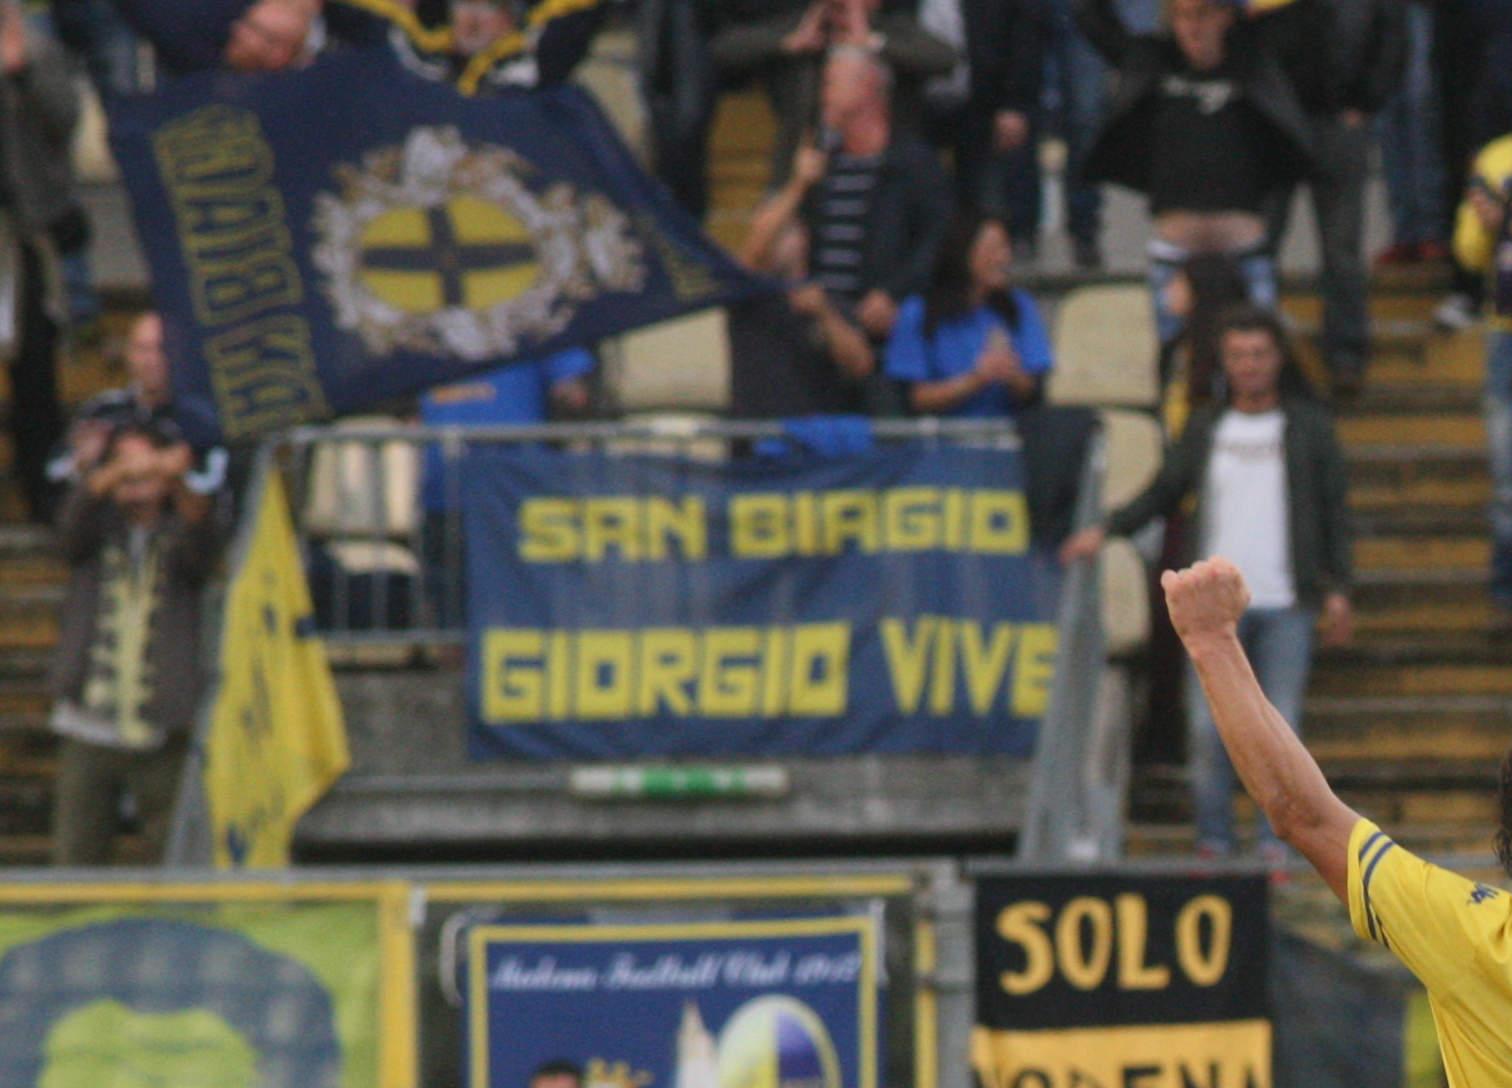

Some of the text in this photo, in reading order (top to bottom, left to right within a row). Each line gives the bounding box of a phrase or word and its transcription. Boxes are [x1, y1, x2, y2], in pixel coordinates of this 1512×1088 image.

[518, 489, 1031, 565] SAN BIAGIO
[481, 614, 1061, 725] GIORGIO VIVE
[996, 892, 1233, 996] SOLO
